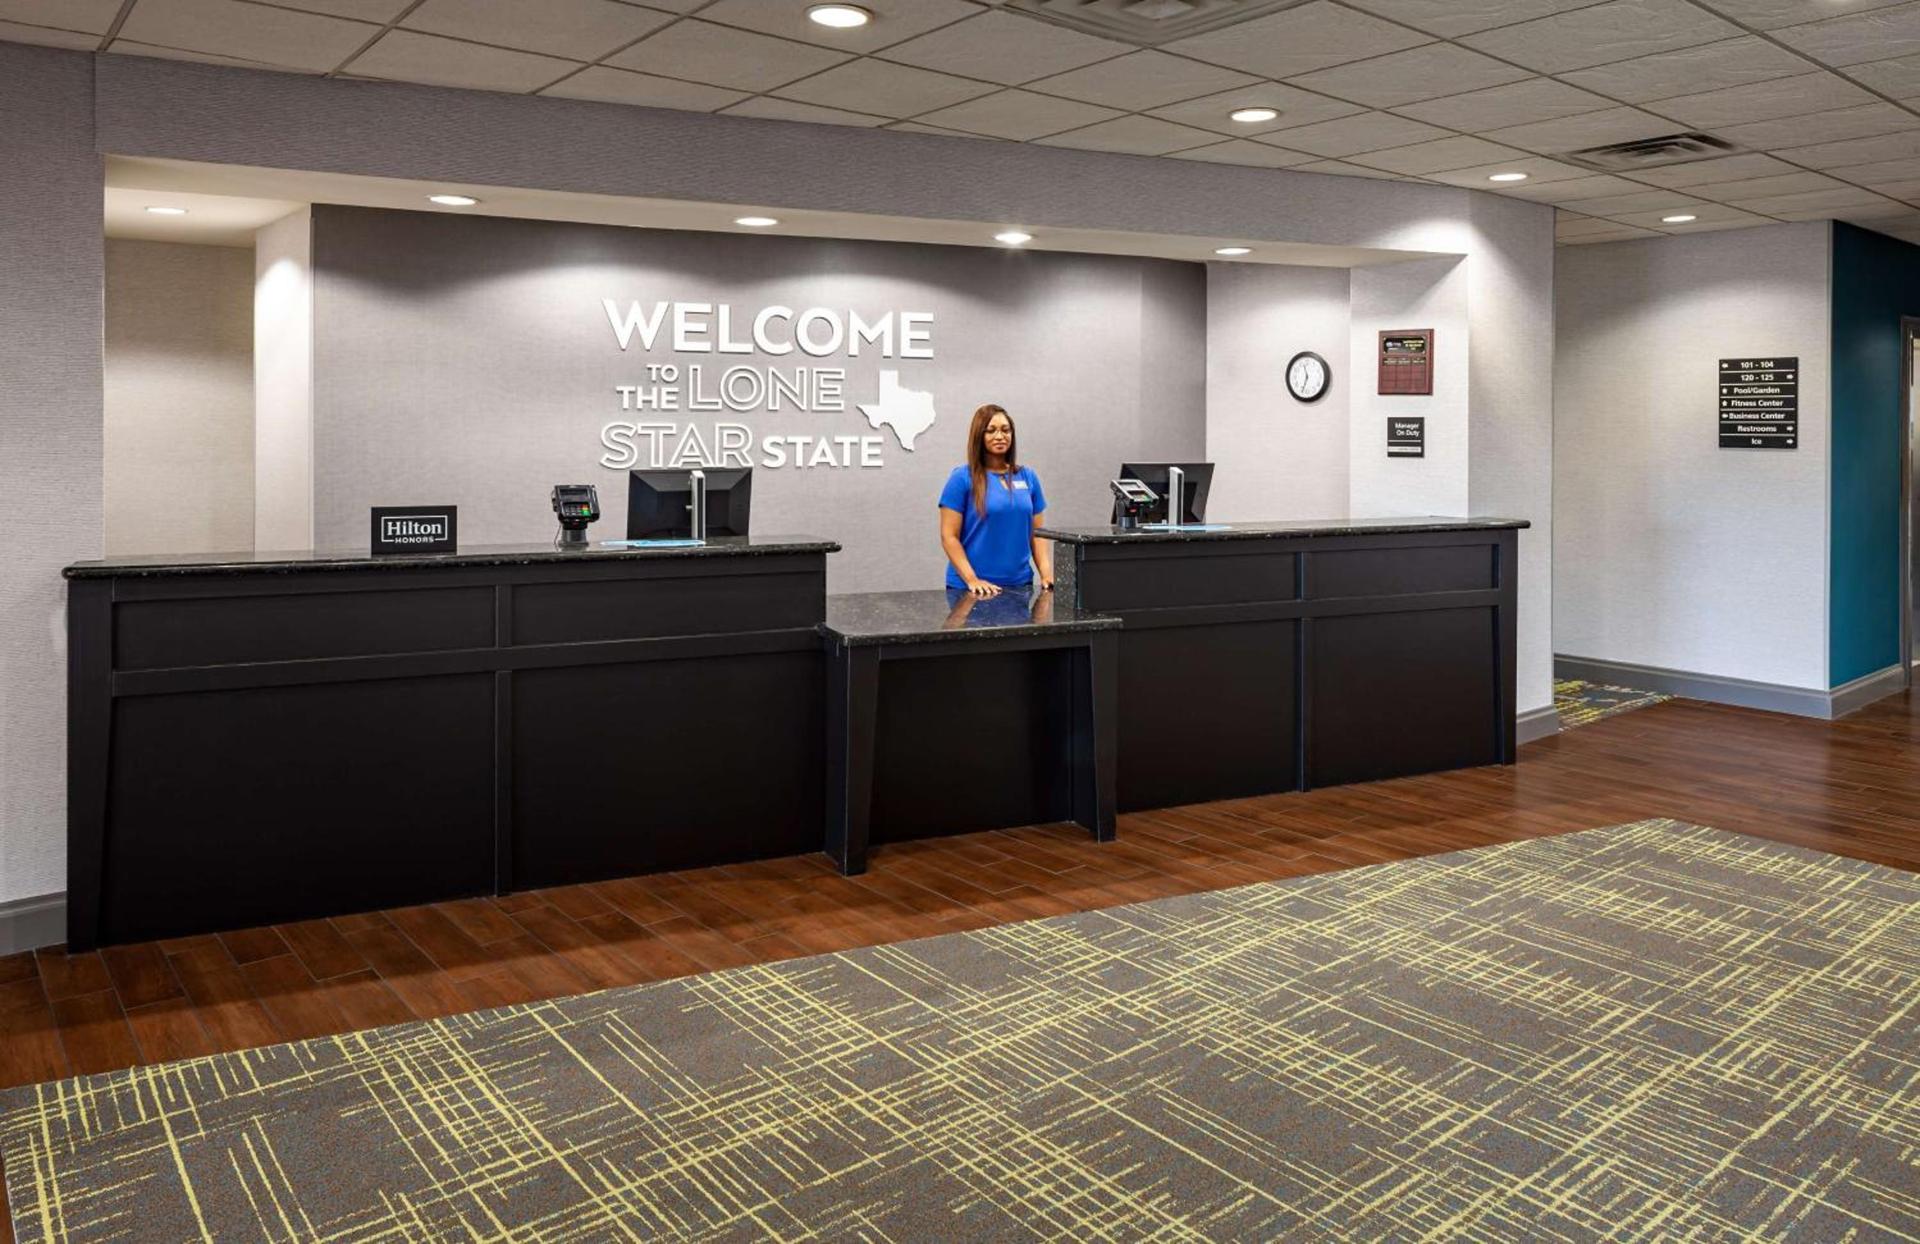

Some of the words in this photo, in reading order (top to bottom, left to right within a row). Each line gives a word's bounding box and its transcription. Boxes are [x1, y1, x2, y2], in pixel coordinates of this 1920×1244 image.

[602, 298, 935, 359] WELCOME
[1740, 361, 1754, 369] 101
[1760, 361, 1774, 369] 104
[646, 364, 679, 383] TO
[689, 365, 846, 413] LONE
[1733, 386, 1781, 395] Pool/Garden
[616, 386, 680, 410] THE
[1729, 412, 1760, 420] Business
[1760, 412, 1786, 420] Center
[1394, 422, 1419, 430] Manager
[1737, 425, 1777, 433] Restrooms
[1406, 429, 1420, 437] Duty
[1751, 437, 1762, 445] Ice
[600, 422, 755, 469] STAR
[761, 436, 884, 468] STATE
[387, 520, 442, 536] Hilton
[395, 536, 435, 544] HONORS
